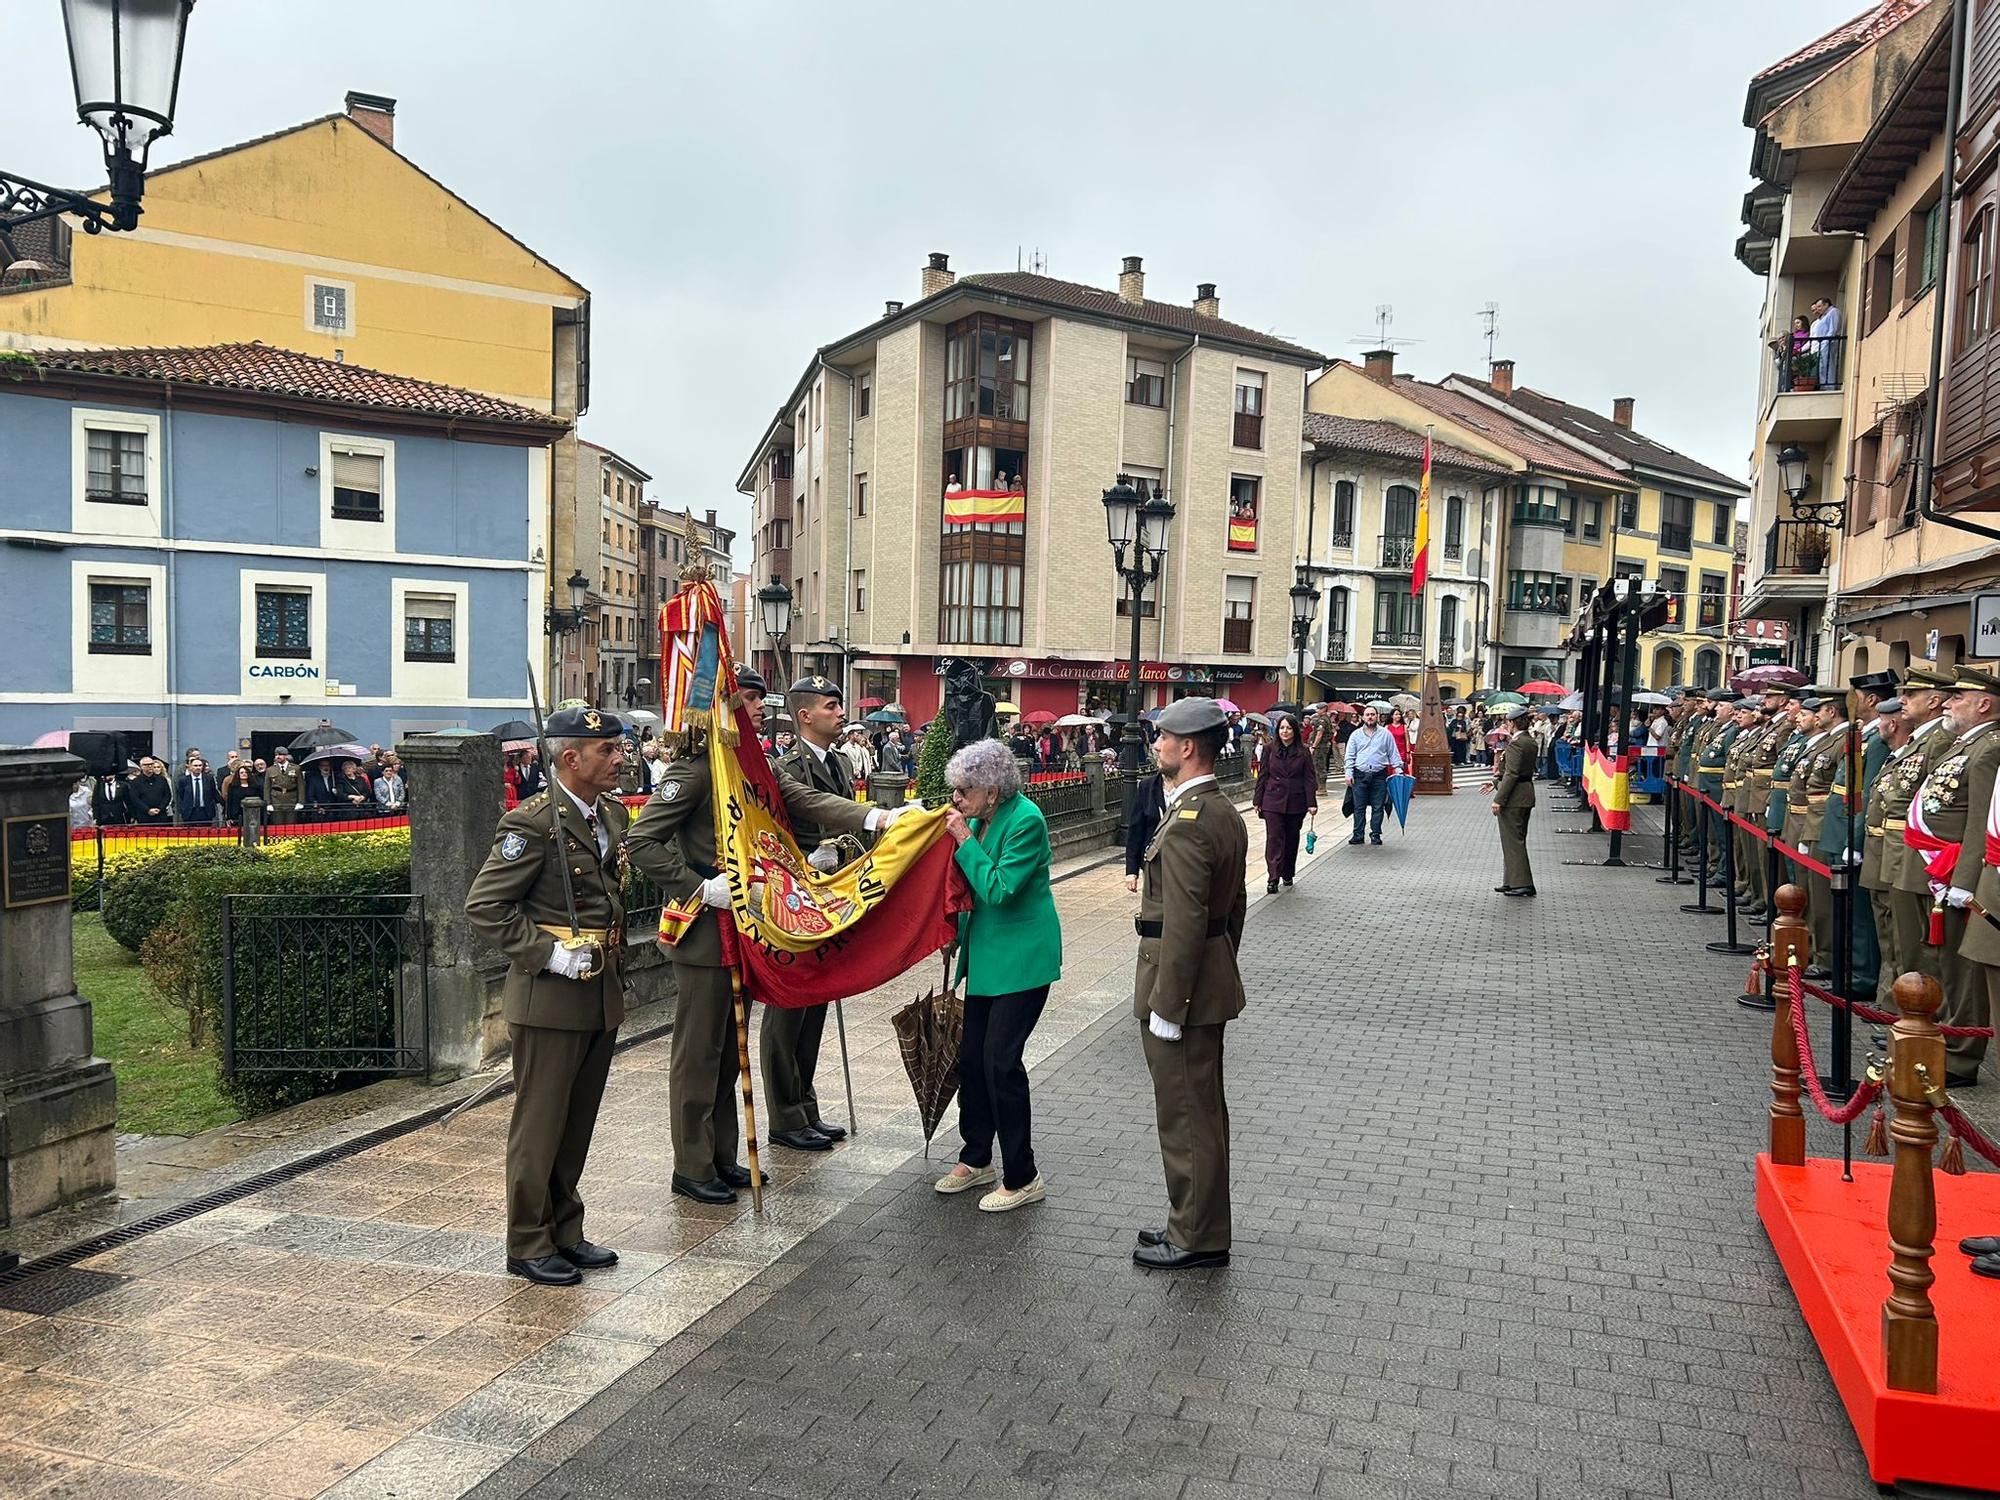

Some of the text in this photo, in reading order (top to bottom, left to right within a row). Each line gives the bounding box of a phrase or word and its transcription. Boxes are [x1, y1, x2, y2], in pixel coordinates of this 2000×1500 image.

[249, 663, 319, 678] CARBÓN
[1029, 663, 1046, 677] La
[1048, 663, 1114, 679] Carnicería
[1117, 664, 1130, 680] de
